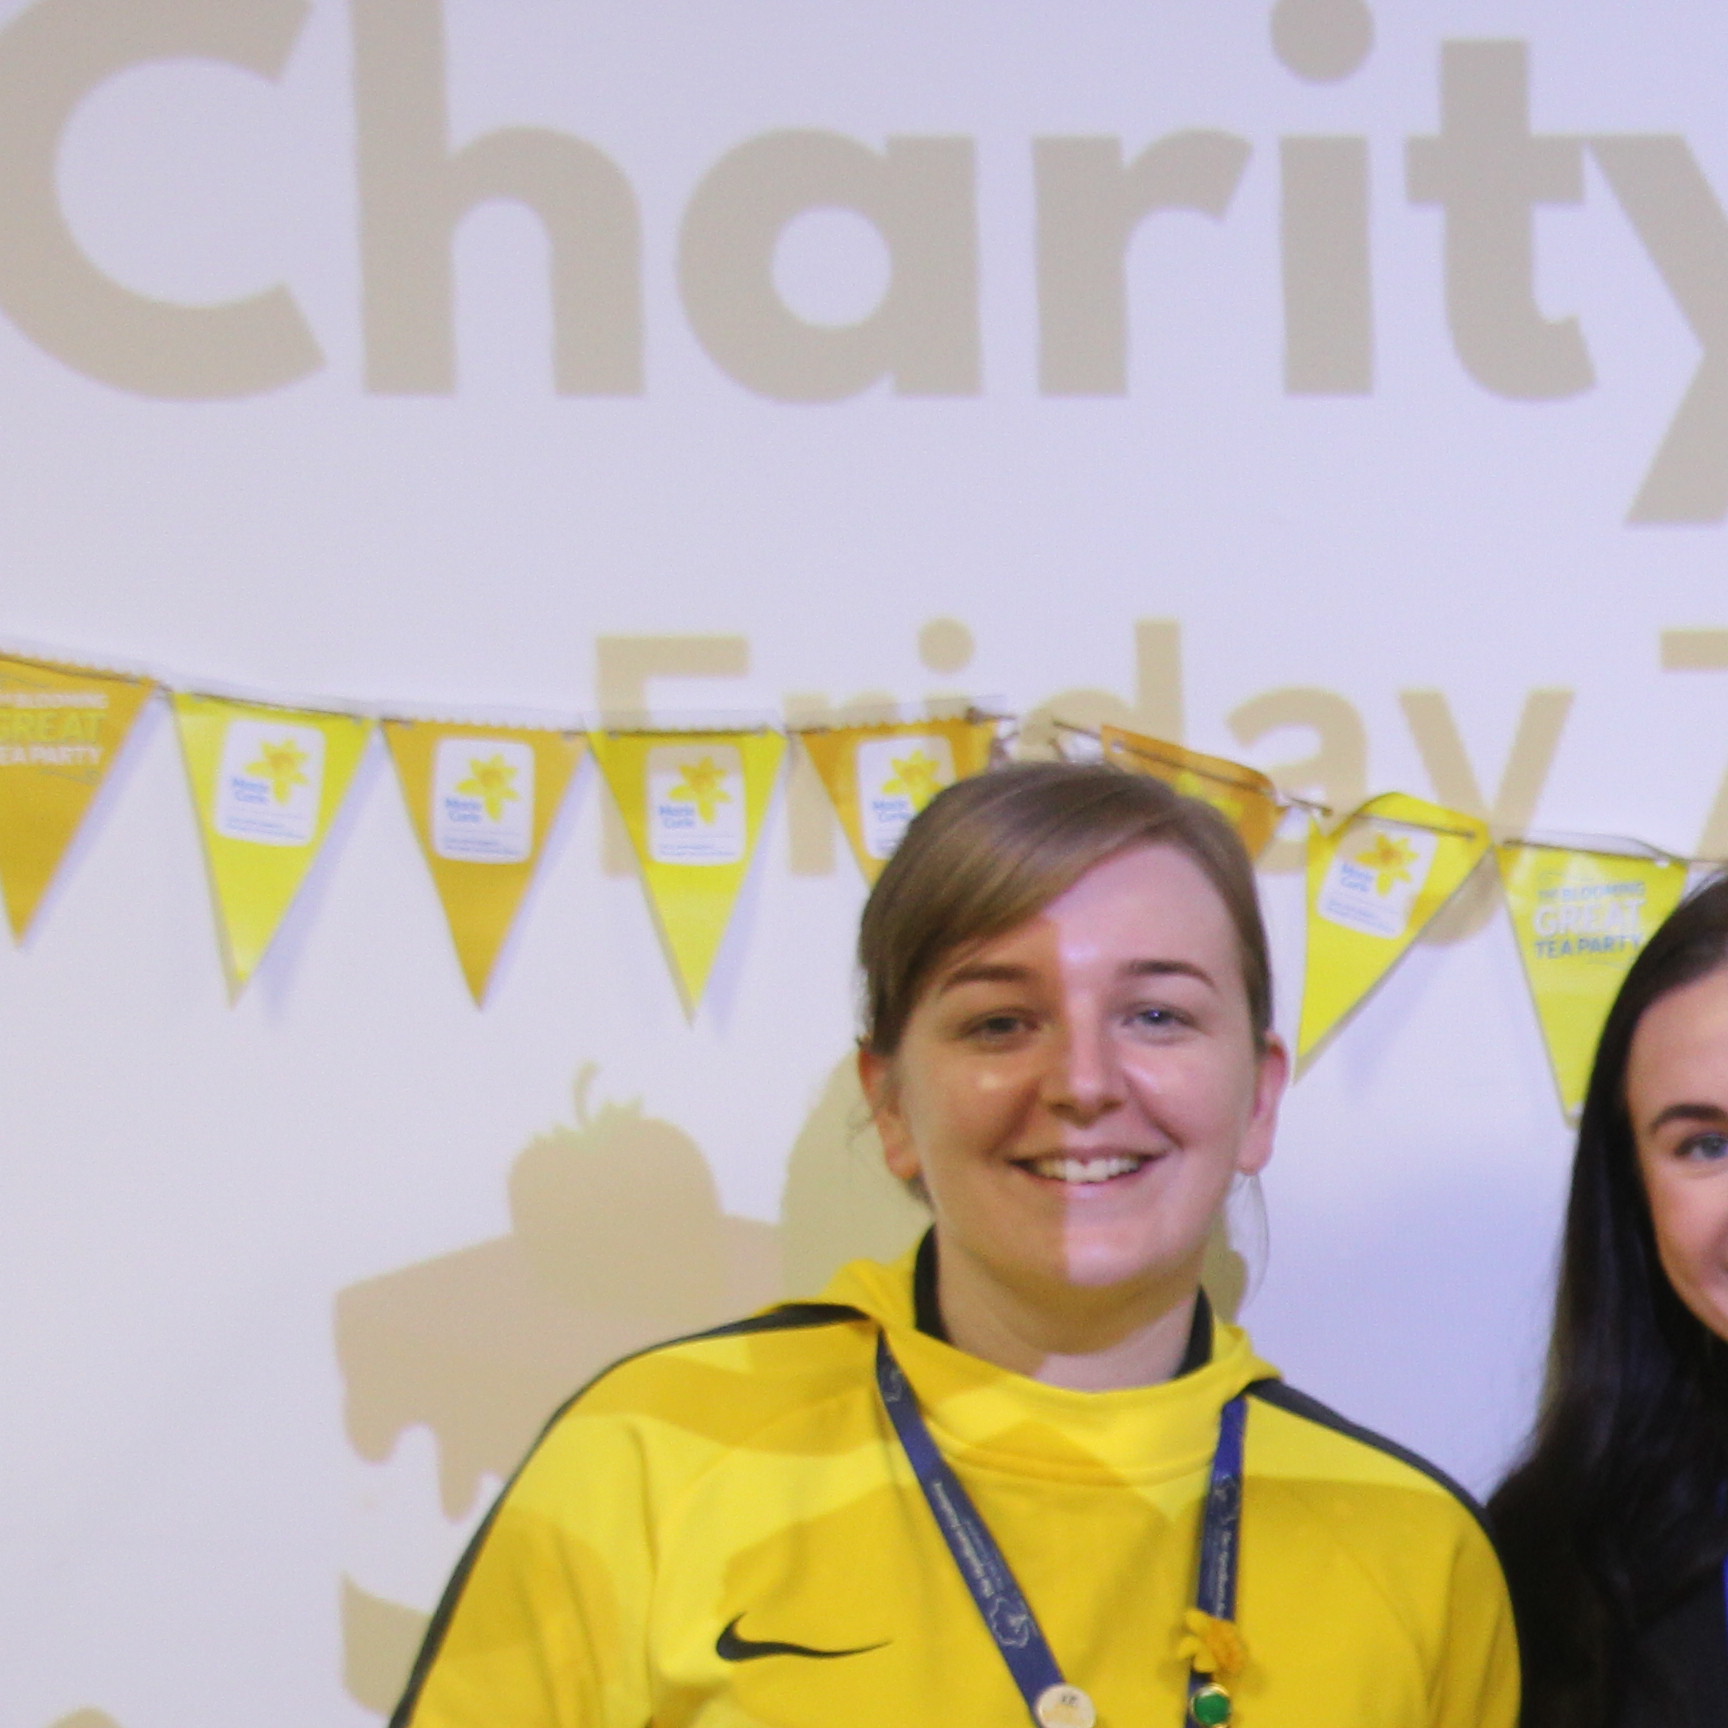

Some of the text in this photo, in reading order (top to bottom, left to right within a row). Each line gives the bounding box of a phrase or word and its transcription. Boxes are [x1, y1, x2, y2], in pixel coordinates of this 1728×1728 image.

[594, 617, 1574, 945] Friday
[1534, 898, 1648, 937] GREAT
[1534, 933, 1644, 959] TEA PARTY
